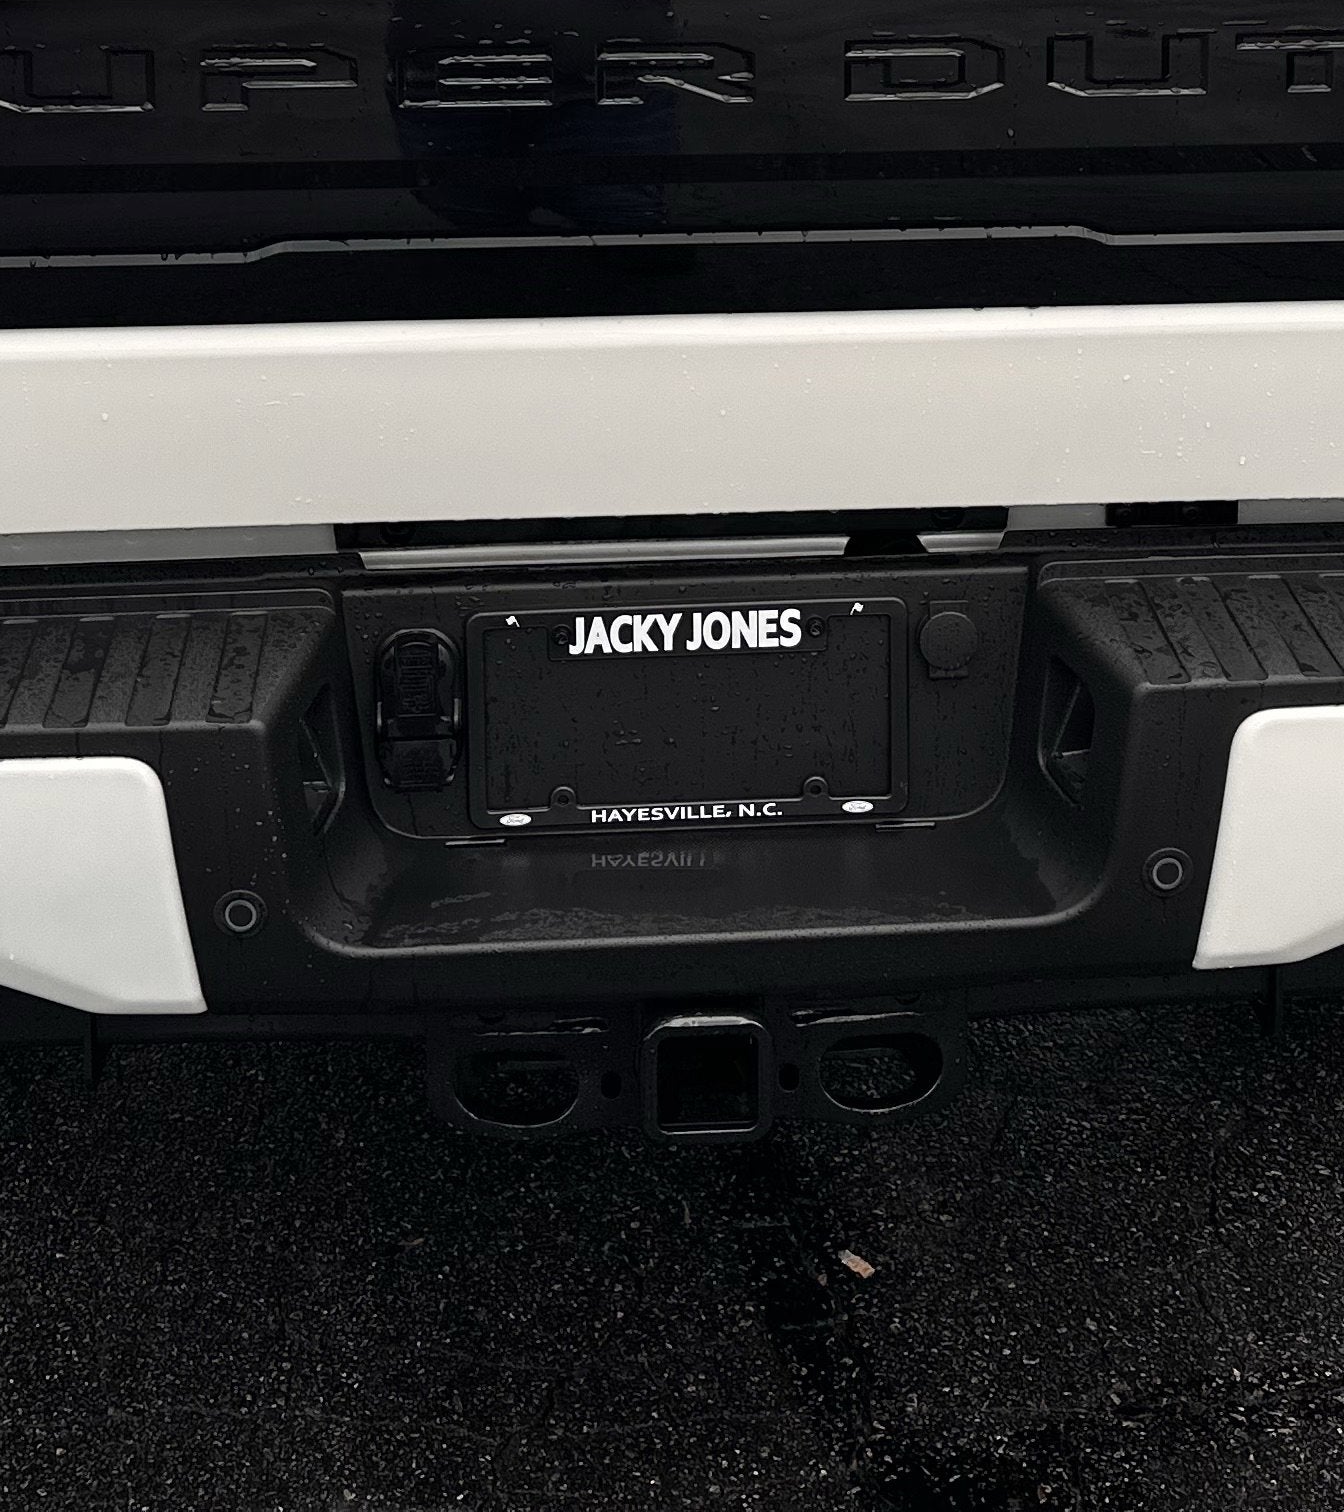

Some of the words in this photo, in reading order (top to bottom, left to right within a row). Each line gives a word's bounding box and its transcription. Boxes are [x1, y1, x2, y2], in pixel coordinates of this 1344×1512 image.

[568, 612, 683, 655] JACKY
[686, 608, 802, 651] JONES
[590, 803, 732, 823] HAYESVILLE,
[738, 802, 783, 817] N.C.
